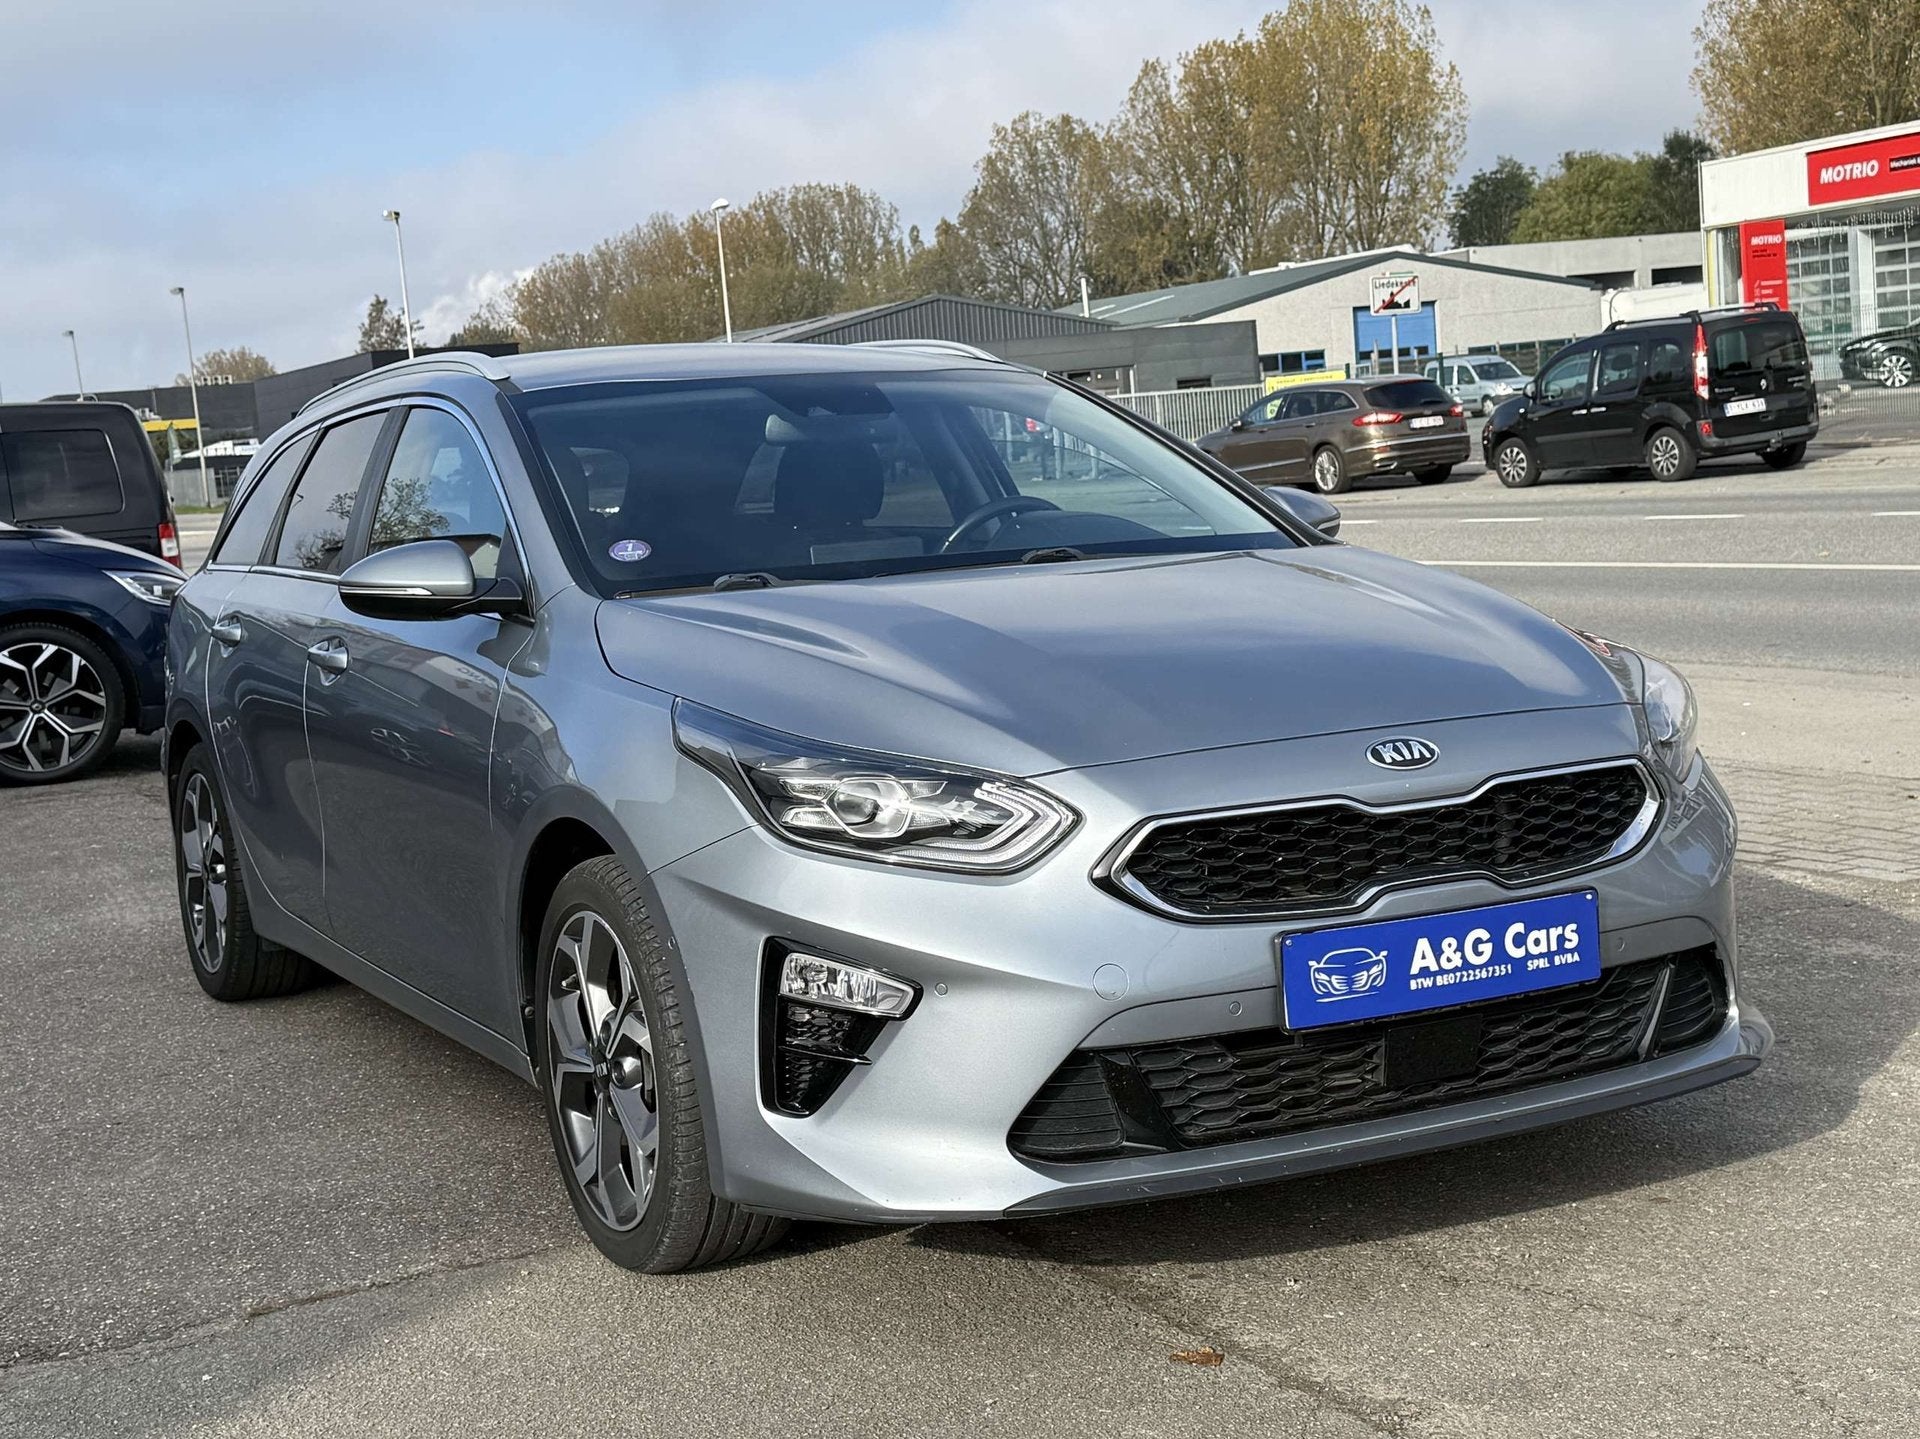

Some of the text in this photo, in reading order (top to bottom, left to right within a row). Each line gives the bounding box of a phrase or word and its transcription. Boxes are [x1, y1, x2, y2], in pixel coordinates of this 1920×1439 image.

[1820, 159, 1879, 185] MOTRIO
[1751, 234, 1782, 246] MOTRIO
[1375, 741, 1432, 763] KIA
[1410, 922, 1579, 975] A&G Cars
[1410, 952, 1580, 990] BTW BE0722567351 SPRL BVBA
